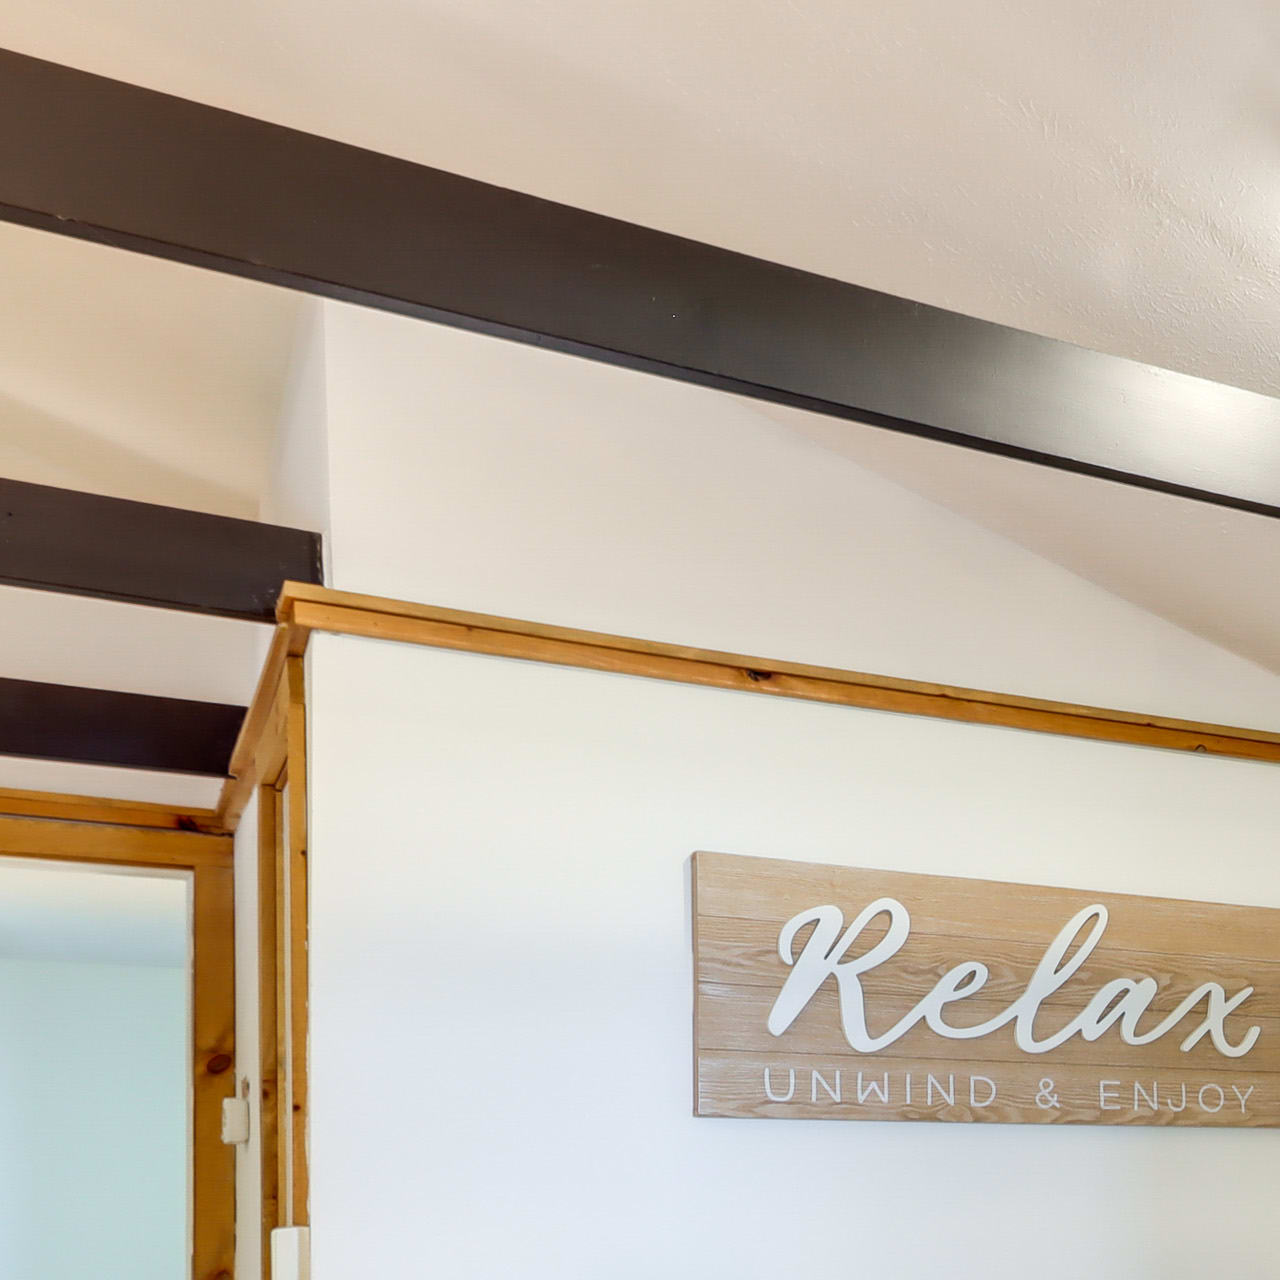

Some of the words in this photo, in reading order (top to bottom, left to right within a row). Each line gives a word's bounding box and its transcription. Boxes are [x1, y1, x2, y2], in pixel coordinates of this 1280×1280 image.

[767, 897, 1261, 1057] Relax
[763, 1066, 998, 1108] UNWIND
[1035, 1077, 1061, 1110] &
[1100, 1079, 1256, 1115] ENJOY
